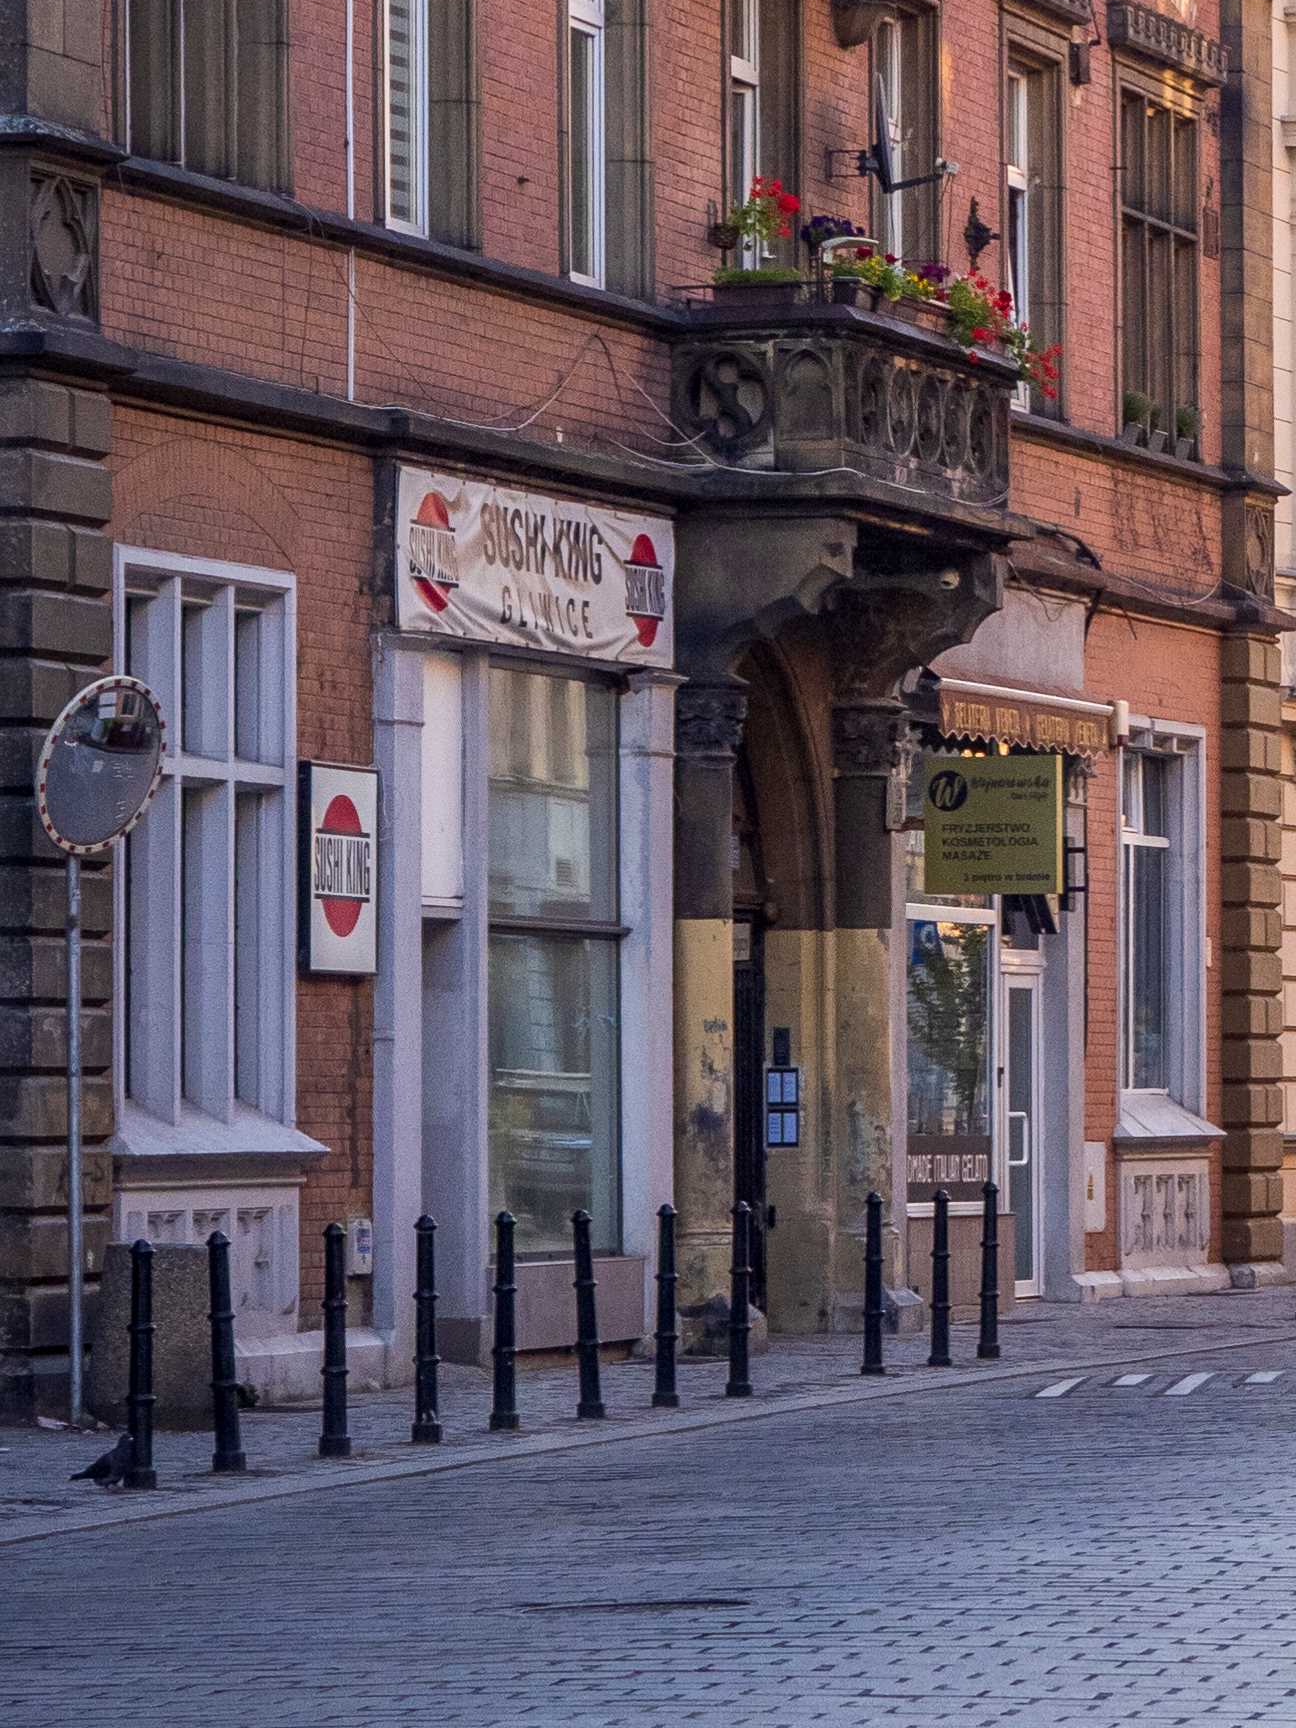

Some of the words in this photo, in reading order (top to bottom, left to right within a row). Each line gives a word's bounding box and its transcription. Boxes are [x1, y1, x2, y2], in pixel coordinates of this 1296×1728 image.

[409, 526, 435, 579] SUSHI
[480, 502, 547, 576] SUSHI
[551, 514, 603, 586] KING
[500, 584, 594, 640] GLIWICE
[625, 567, 646, 612] SUSHI
[647, 570, 666, 616] KING
[942, 823, 1031, 834] FRYZJERSTWO
[942, 836, 1039, 847] KOSMETOLOGIA
[314, 835, 343, 893] SUSHI
[346, 839, 371, 896] KING
[942, 849, 992, 861] MASAŻE
